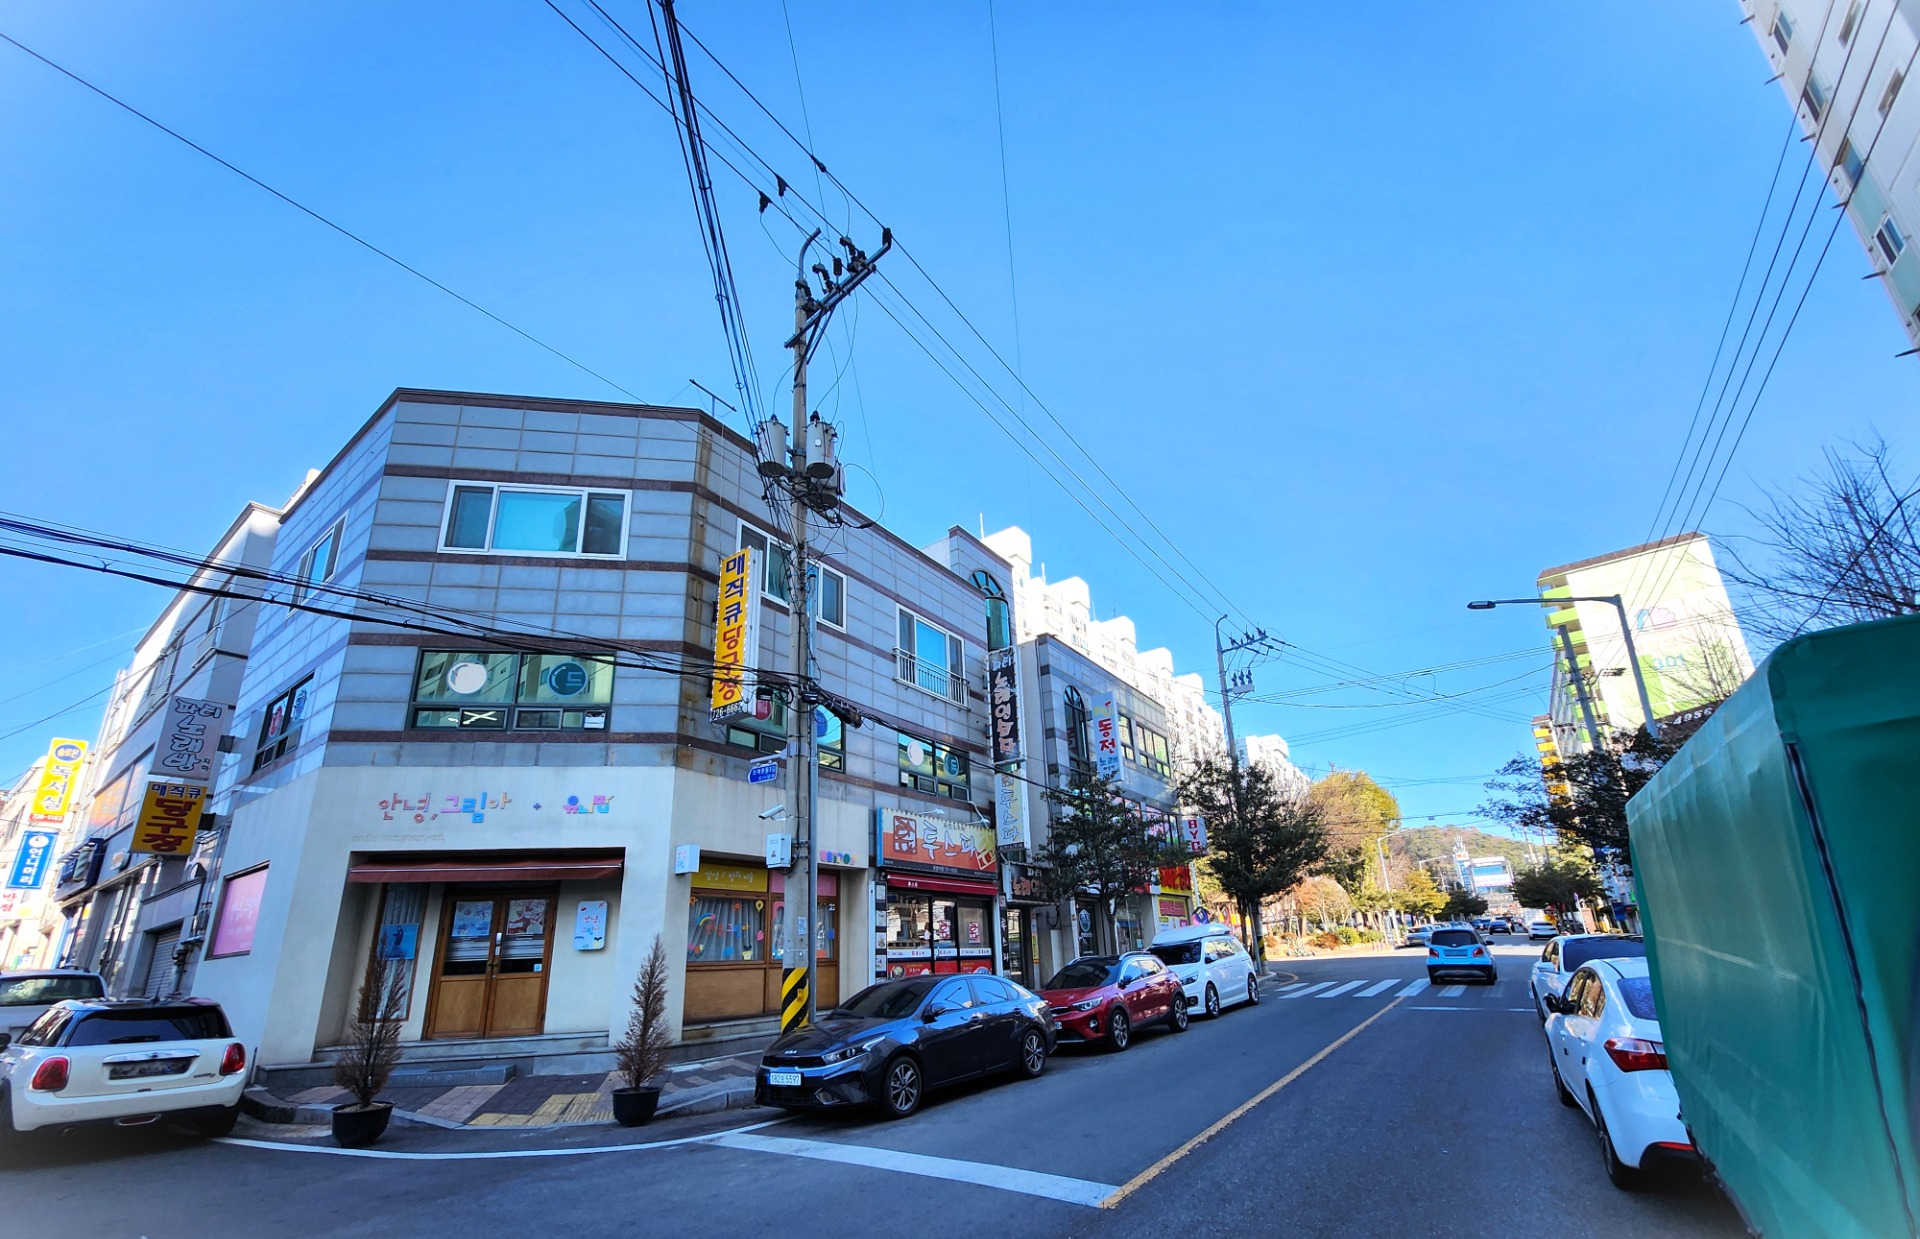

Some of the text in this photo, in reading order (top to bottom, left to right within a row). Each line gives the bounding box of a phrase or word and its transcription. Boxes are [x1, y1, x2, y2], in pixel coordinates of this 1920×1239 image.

[175, 698, 222, 719] 파티
[162, 715, 207, 771] 노래방
[1097, 717, 1117, 755] 동전
[1099, 756, 1119, 767] 노래
[43, 765, 73, 810] 독서실
[151, 783, 202, 798] 매직큐
[141, 797, 197, 853] 당구장
[1187, 819, 1202, 852] BYC
